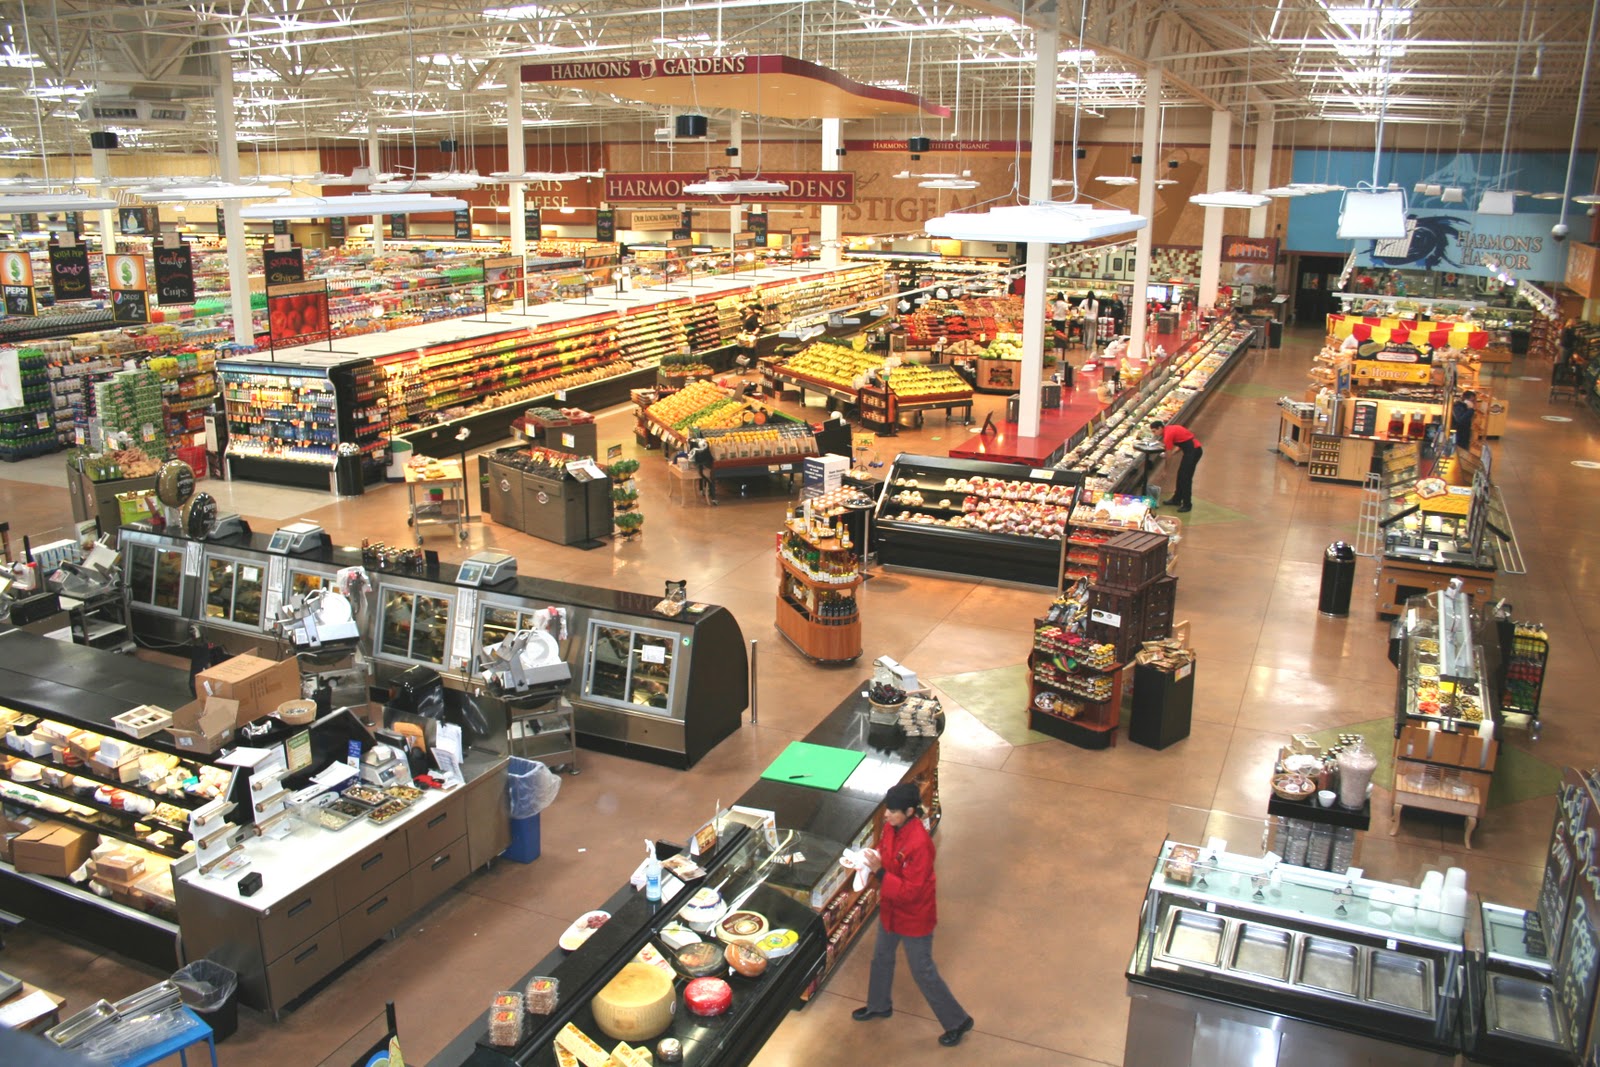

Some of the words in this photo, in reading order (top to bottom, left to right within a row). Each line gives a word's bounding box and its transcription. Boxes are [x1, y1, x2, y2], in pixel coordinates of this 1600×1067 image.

[551, 61, 631, 80] HARMONS
[663, 56, 745, 75] GARDENS
[955, 142, 990, 150] ORGANIC
[527, 180, 563, 192] EATS
[609, 180, 705, 197] HARMO
[489, 193, 501, 207] &
[1456, 231, 1543, 253] HARMONS
[55, 263, 84, 276] Candy
[5, 287, 28, 295] PEPSI
[1371, 367, 1409, 380] Honey
